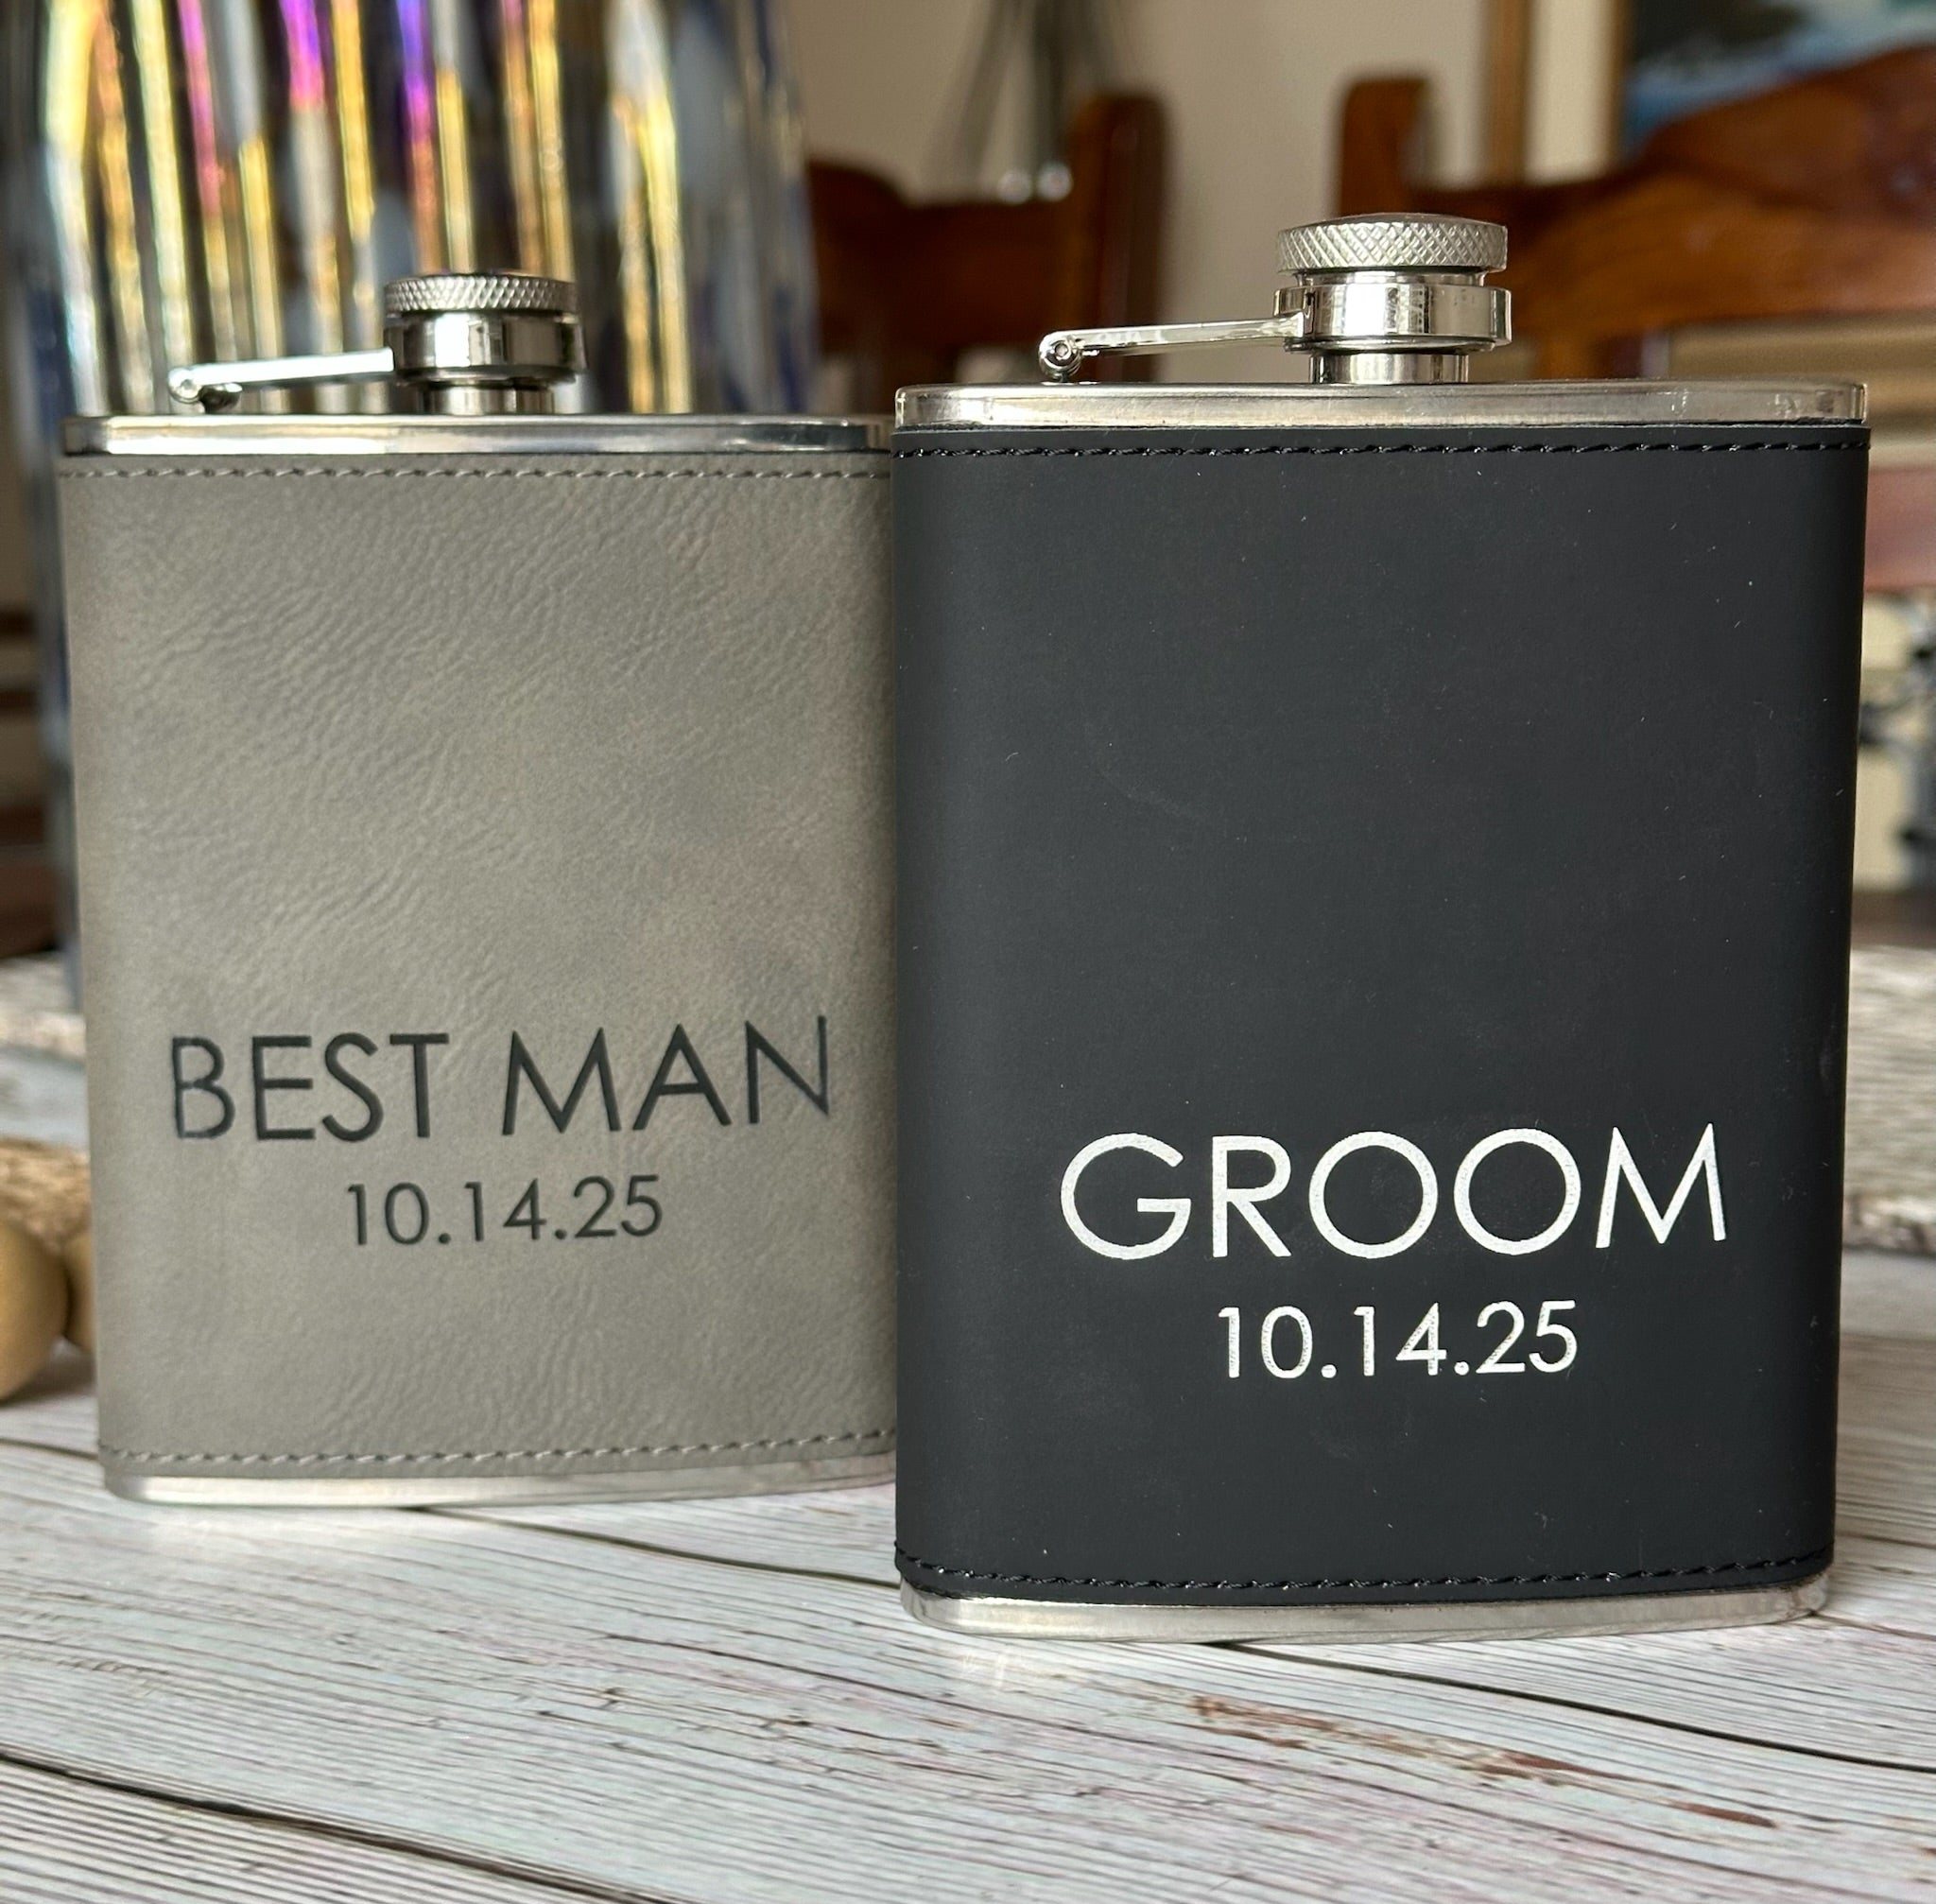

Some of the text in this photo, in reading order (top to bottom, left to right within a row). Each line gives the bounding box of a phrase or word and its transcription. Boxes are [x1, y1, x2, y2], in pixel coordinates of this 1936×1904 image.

[169, 1014, 830, 1142] BEST MAN
[345, 1173, 664, 1247] 10.14.25
[1060, 1122, 1727, 1261] GROOM
[1217, 1299, 1579, 1379] 10.14.25
